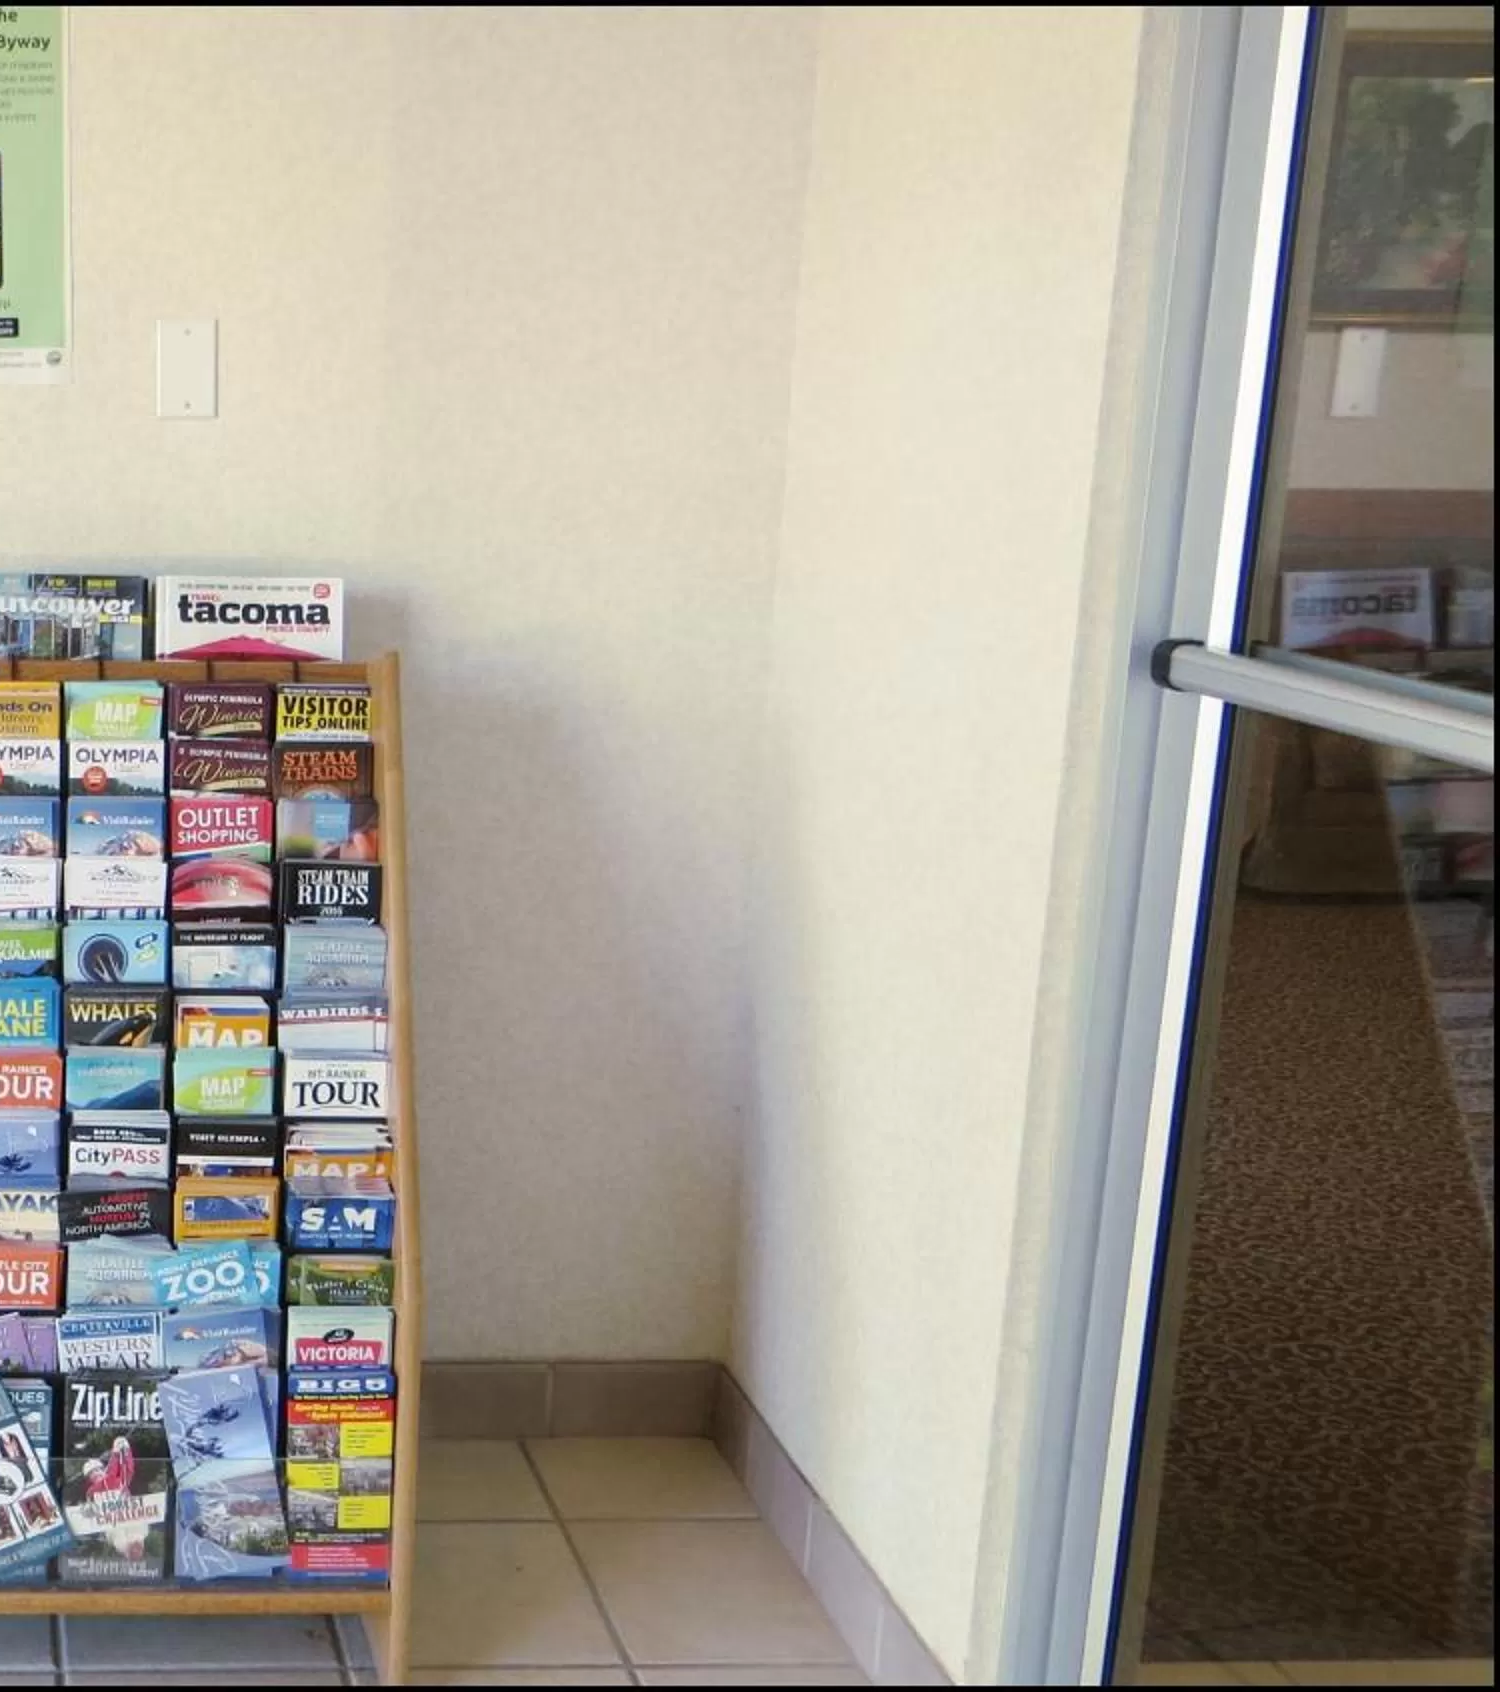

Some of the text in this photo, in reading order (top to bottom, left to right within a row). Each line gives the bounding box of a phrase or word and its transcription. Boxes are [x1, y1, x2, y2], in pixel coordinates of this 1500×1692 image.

[178, 593, 330, 624] tacoma
[28, 701, 52, 712] On
[184, 694, 263, 705] OLYMPIC PENINSULA
[284, 696, 368, 716] VISITOR
[95, 702, 137, 722] MAP
[283, 717, 367, 731] TIPS ONLINE
[75, 748, 158, 763] OLYMPIA
[283, 751, 356, 767] STEAM
[282, 766, 357, 781] TRAINS
[178, 807, 259, 828] OUTLET
[178, 829, 260, 844] SHOPPING
[297, 870, 369, 884] STEAM TRAIN
[297, 886, 369, 905] RIDES
[70, 1003, 157, 1023] WHALES
[281, 1007, 369, 1019] WARBIRDS
[189, 1026, 264, 1048] MAP
[1, 1064, 48, 1074] RAINIER
[202, 1076, 245, 1096] MAP
[292, 1082, 380, 1108] TOUR
[189, 1134, 259, 1143] VISIT OLYMPIA
[74, 1148, 161, 1165] CityPASS
[293, 1162, 370, 1177] MAP
[65, 1219, 151, 1236] NORTH AMERICA
[23, 1260, 49, 1272] CITY
[160, 1261, 244, 1300] ZOO
[62, 1319, 149, 1333] CENTERVILLE
[64, 1337, 151, 1355] WESTERN
[300, 1347, 375, 1361] VICTORIA
[67, 1352, 151, 1369] WEAR
[297, 1378, 387, 1392] BIG 5
[71, 1384, 163, 1428] Zip Line
